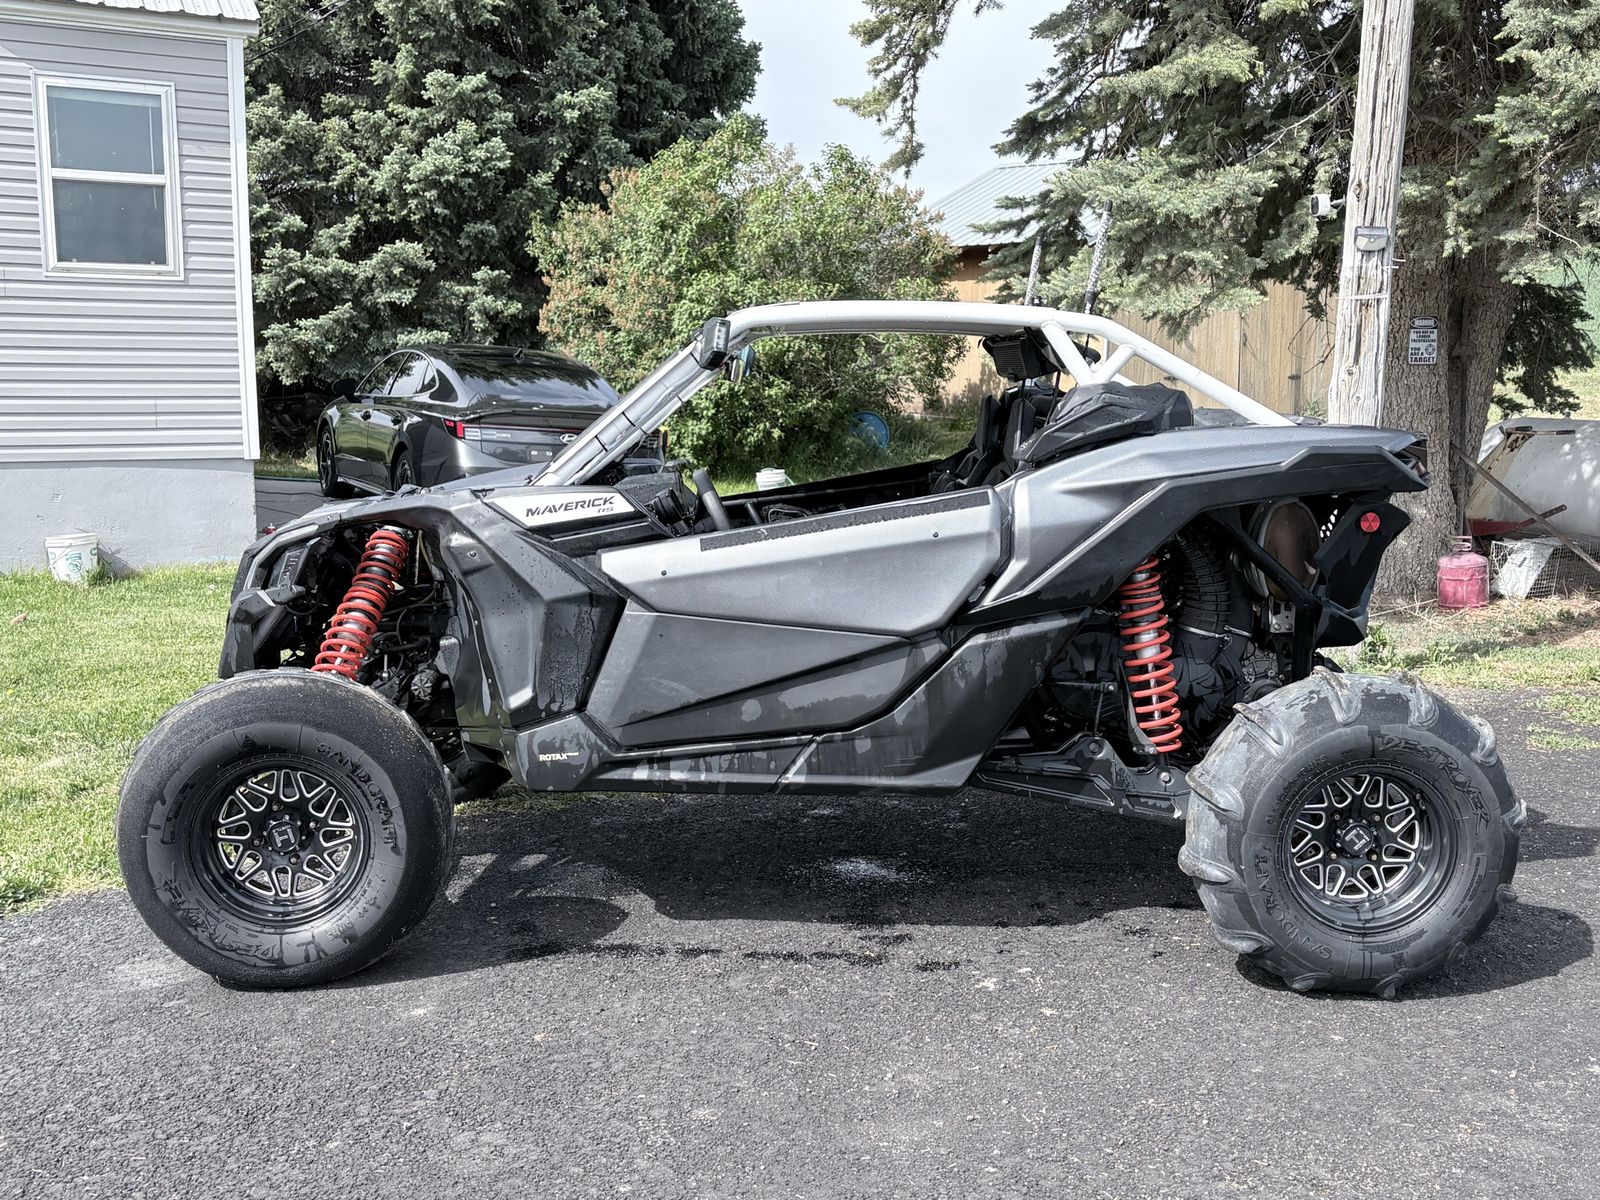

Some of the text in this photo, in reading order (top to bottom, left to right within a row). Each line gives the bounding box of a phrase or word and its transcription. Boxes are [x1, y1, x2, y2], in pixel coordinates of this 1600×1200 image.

[525, 495, 616, 518] MAVERICK
[597, 506, 615, 514] RS
[539, 751, 568, 762] ROTAX
[315, 743, 397, 848] SANDCRAFT
[1255, 854, 1334, 960] SANDCRAFT
